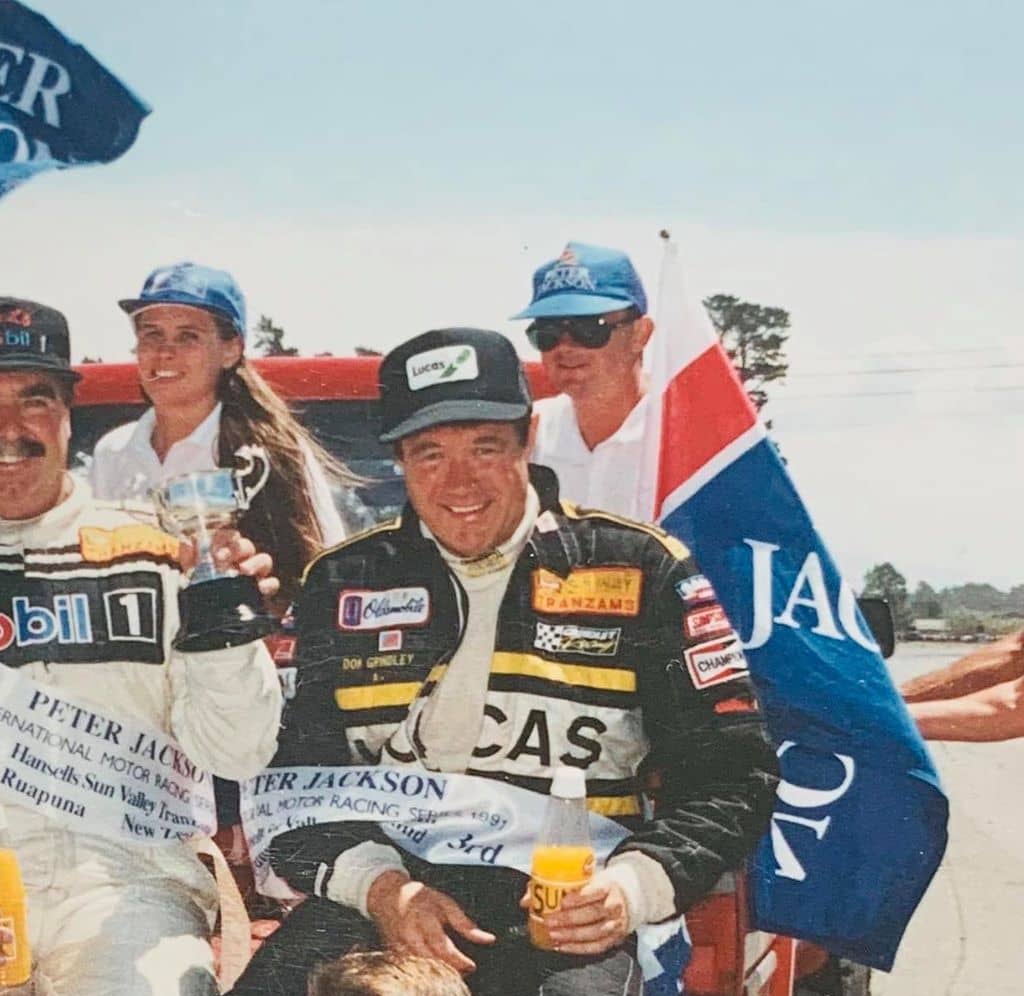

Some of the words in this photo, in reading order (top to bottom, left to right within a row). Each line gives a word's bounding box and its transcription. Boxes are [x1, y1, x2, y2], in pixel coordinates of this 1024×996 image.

[412, 360, 446, 377] Lucas
[29, 690, 123, 745] PETER
[11, 742, 79, 786] Hansells
[82, 771, 115, 798] Sun
[121, 784, 156, 817] Valley
[100, 752, 151, 784] MOTOR
[302, 770, 447, 801] JACKSON
[0, 767, 86, 818] Ruapuna
[122, 813, 155, 840] New
[329, 794, 400, 817] RACING
[448, 833, 505, 865] 3rd
